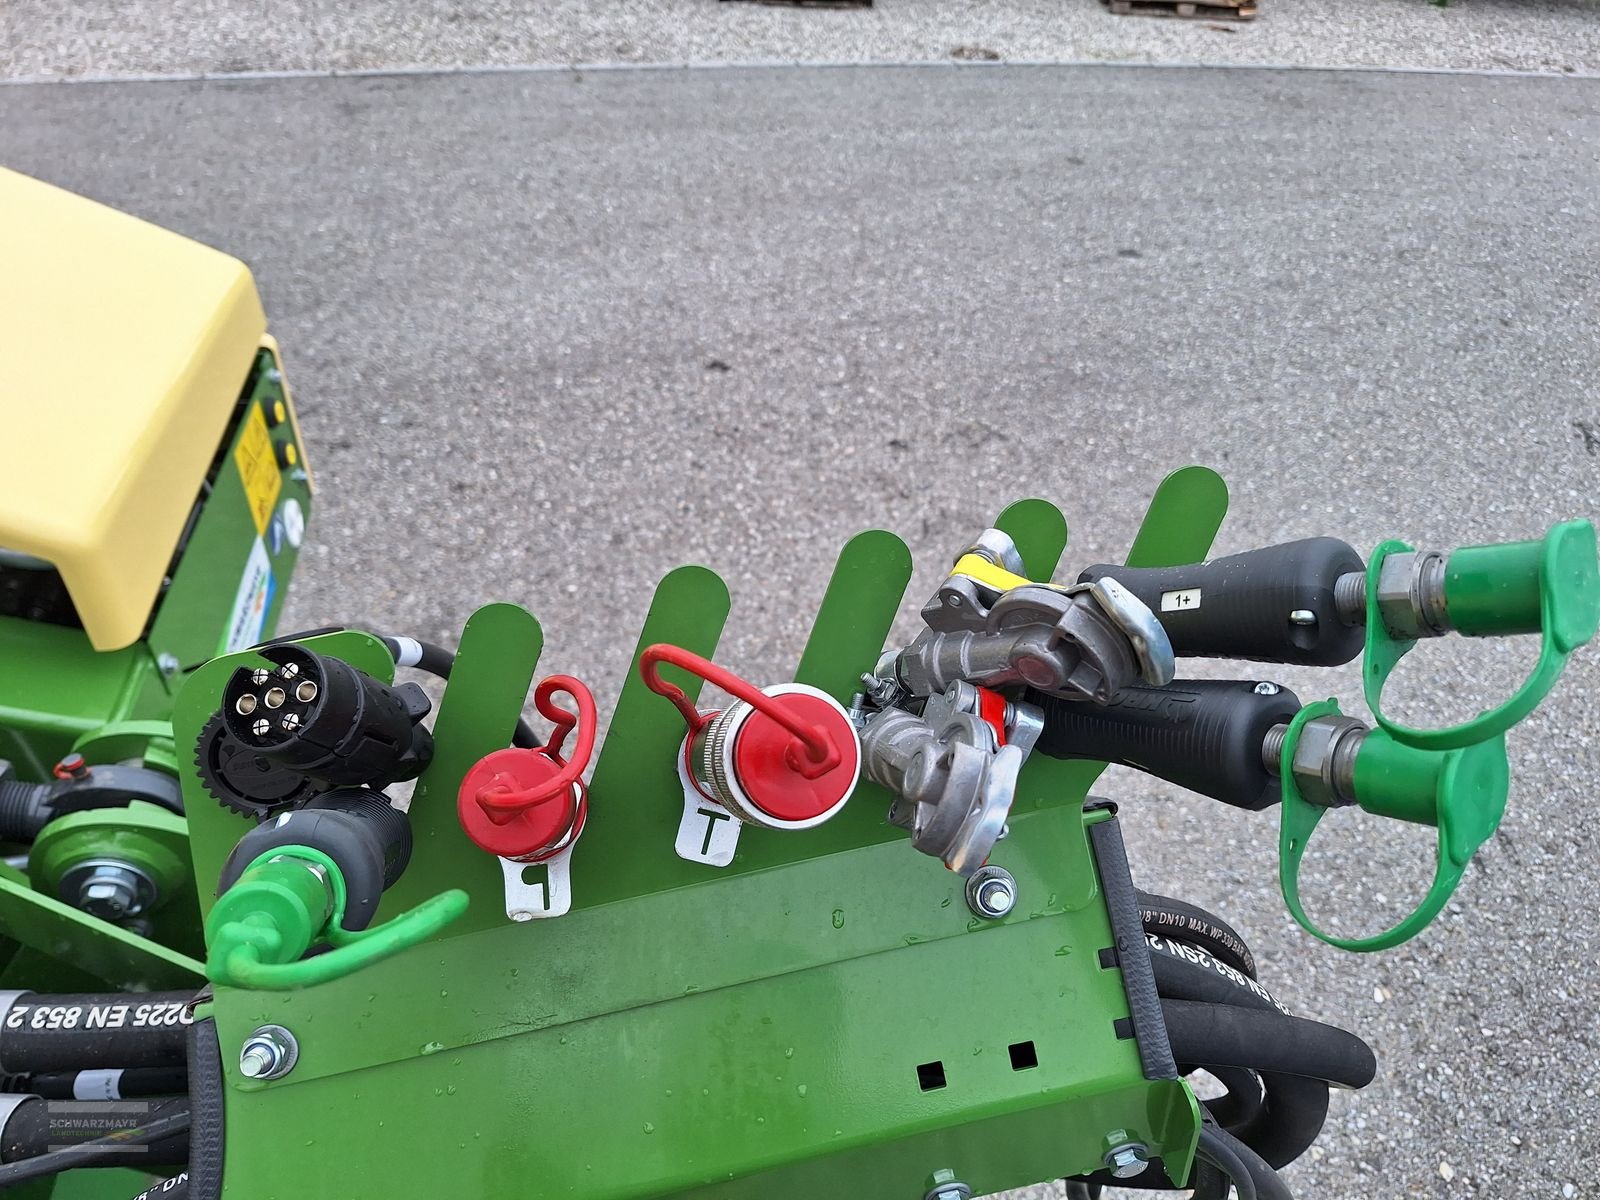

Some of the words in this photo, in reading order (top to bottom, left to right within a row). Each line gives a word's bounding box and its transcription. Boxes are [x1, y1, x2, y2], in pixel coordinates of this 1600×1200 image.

[1176, 594, 1191, 607] 1+
[1158, 912, 1185, 927] DN10
[1188, 917, 1208, 936] MAX.
[1209, 926, 1223, 941] WP
[1165, 938, 1211, 968] 2SN
[1211, 957, 1246, 986] 853
[31, 1006, 81, 1028] 853
[86, 1005, 131, 1028] EN
